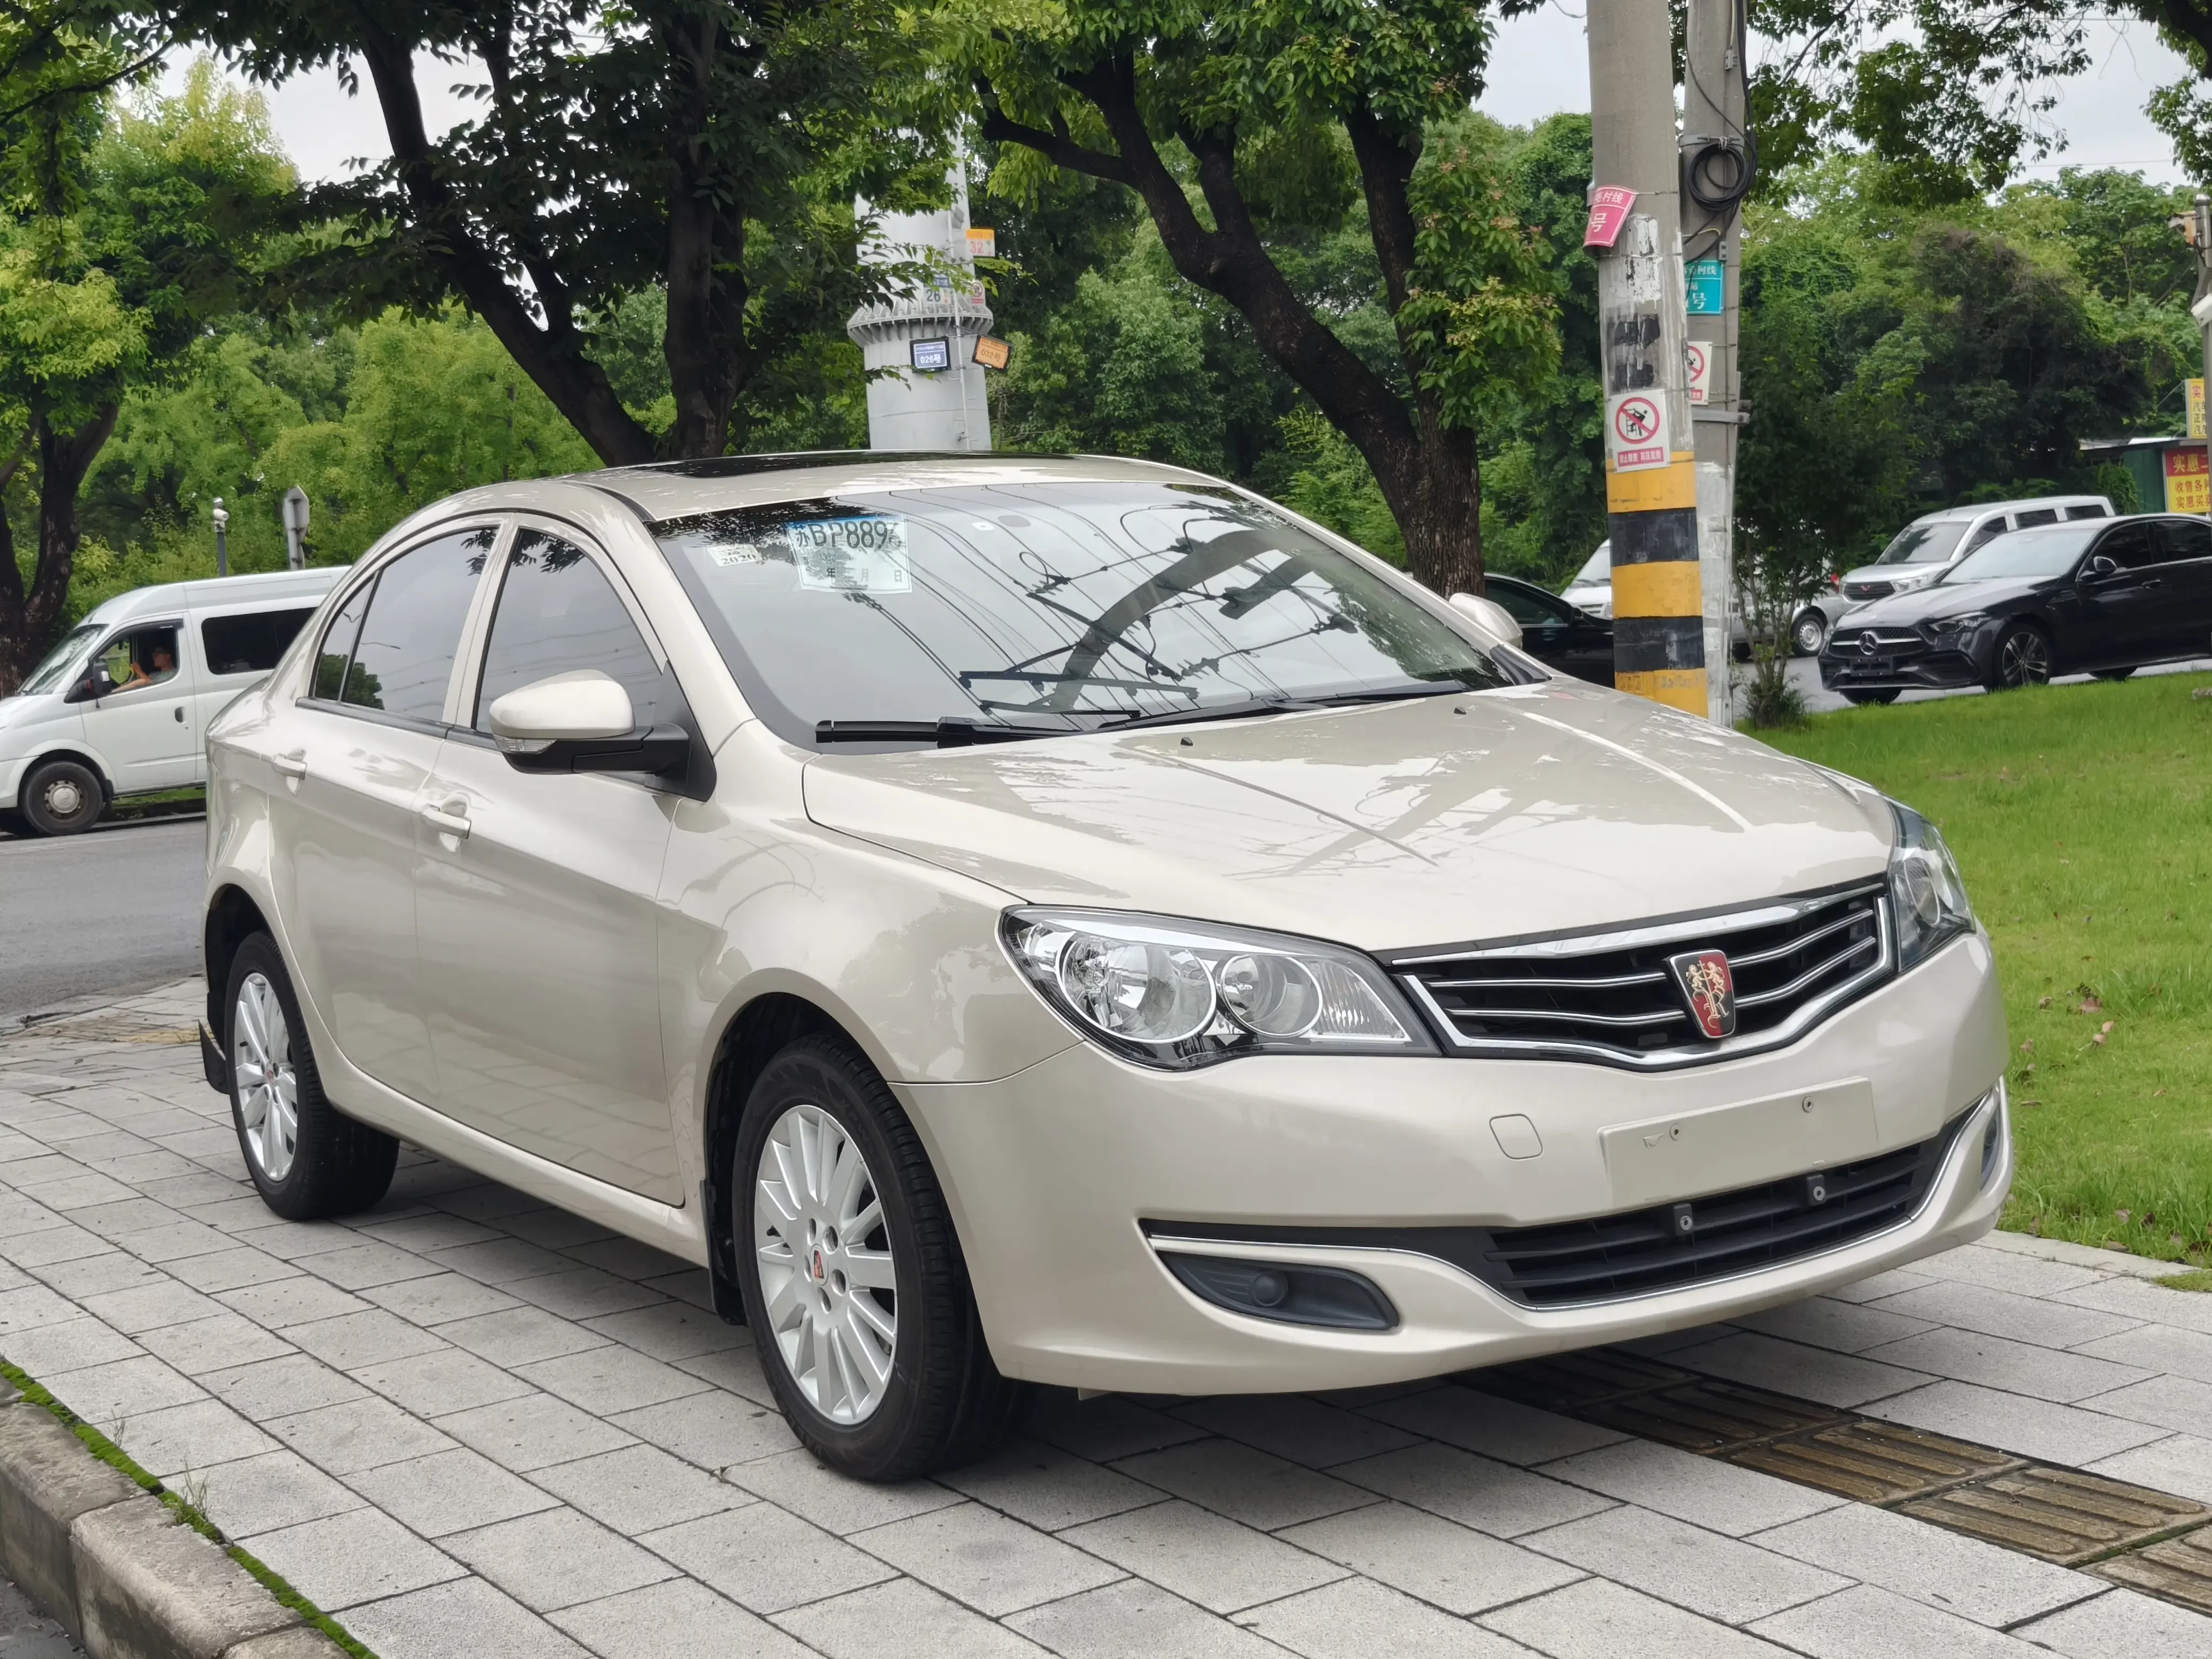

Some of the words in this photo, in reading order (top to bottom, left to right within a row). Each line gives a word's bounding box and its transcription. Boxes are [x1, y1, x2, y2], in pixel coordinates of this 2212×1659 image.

[1591, 213, 1607, 232] 号
[970, 241, 983, 253] 32
[926, 289, 941, 302] 26
[721, 554, 757, 564] 2020
[826, 567, 836, 578] 年
[861, 568, 869, 582] 月
[894, 569, 902, 583] 日
